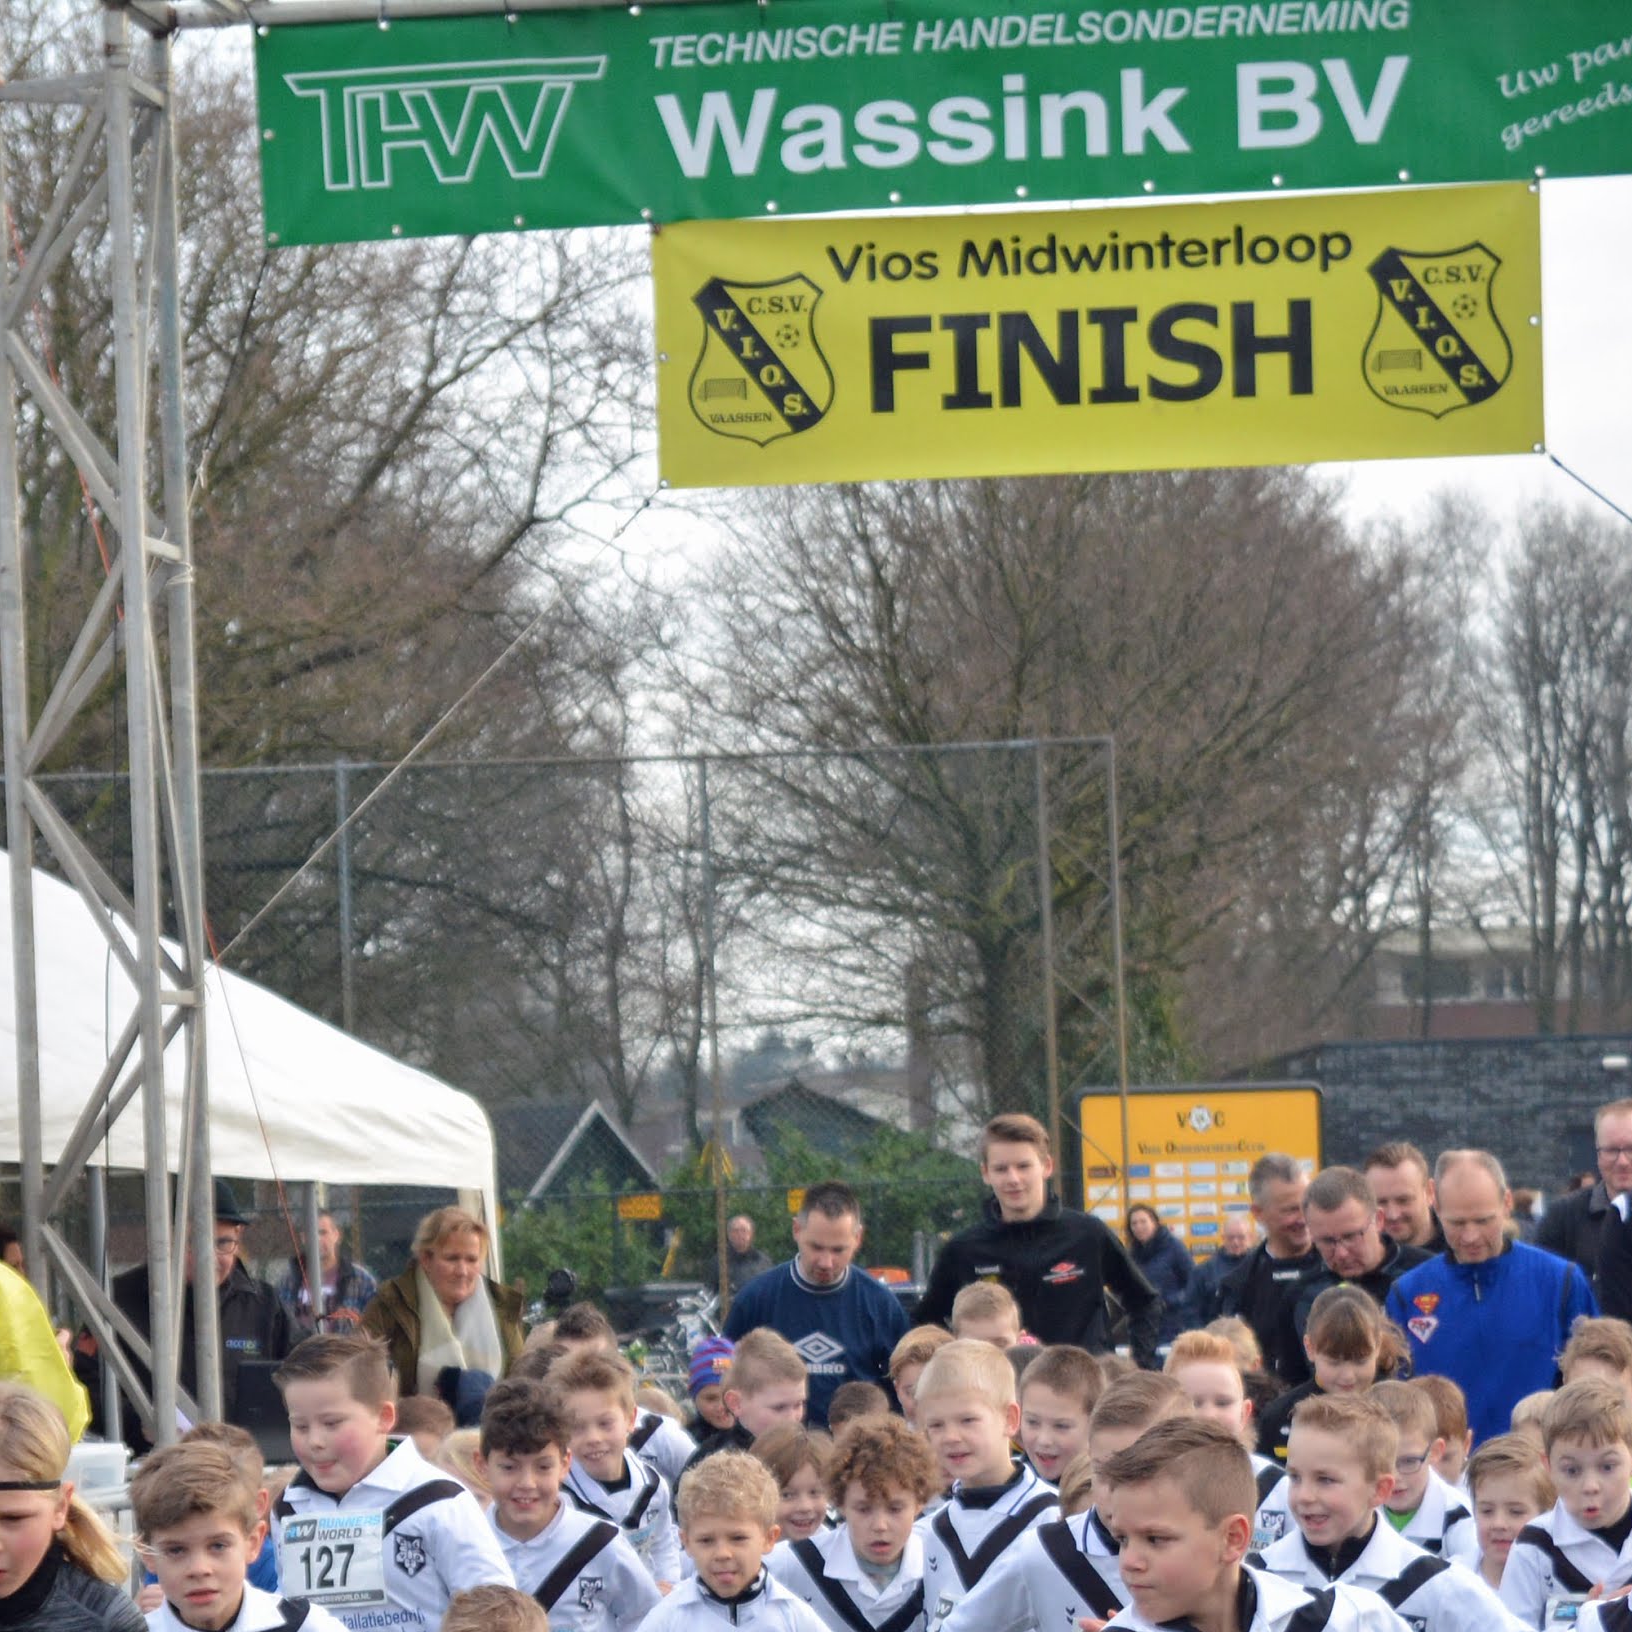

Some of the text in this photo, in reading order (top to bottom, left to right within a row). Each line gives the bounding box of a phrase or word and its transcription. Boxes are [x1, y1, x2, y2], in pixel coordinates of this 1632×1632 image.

[649, 0, 1410, 68] TECHNISCHE HANDELSONDERNEMING
[1496, 62, 1560, 98] Uw
[654, 56, 1410, 179] Wassink BV
[825, 224, 1354, 283] Vios Midwinterloop
[1423, 264, 1486, 285] C.S.V.
[746, 295, 808, 315] C.S.V.
[868, 298, 1315, 414] FINISH
[709, 412, 773, 424] VAASSEN
[807, 1363, 845, 1374] BRO
[317, 1514, 381, 1529] RUNNERS
[317, 1527, 362, 1541] WORLD
[300, 1544, 355, 1590] 127
[343, 1607, 426, 1630] tallatiebedrij
